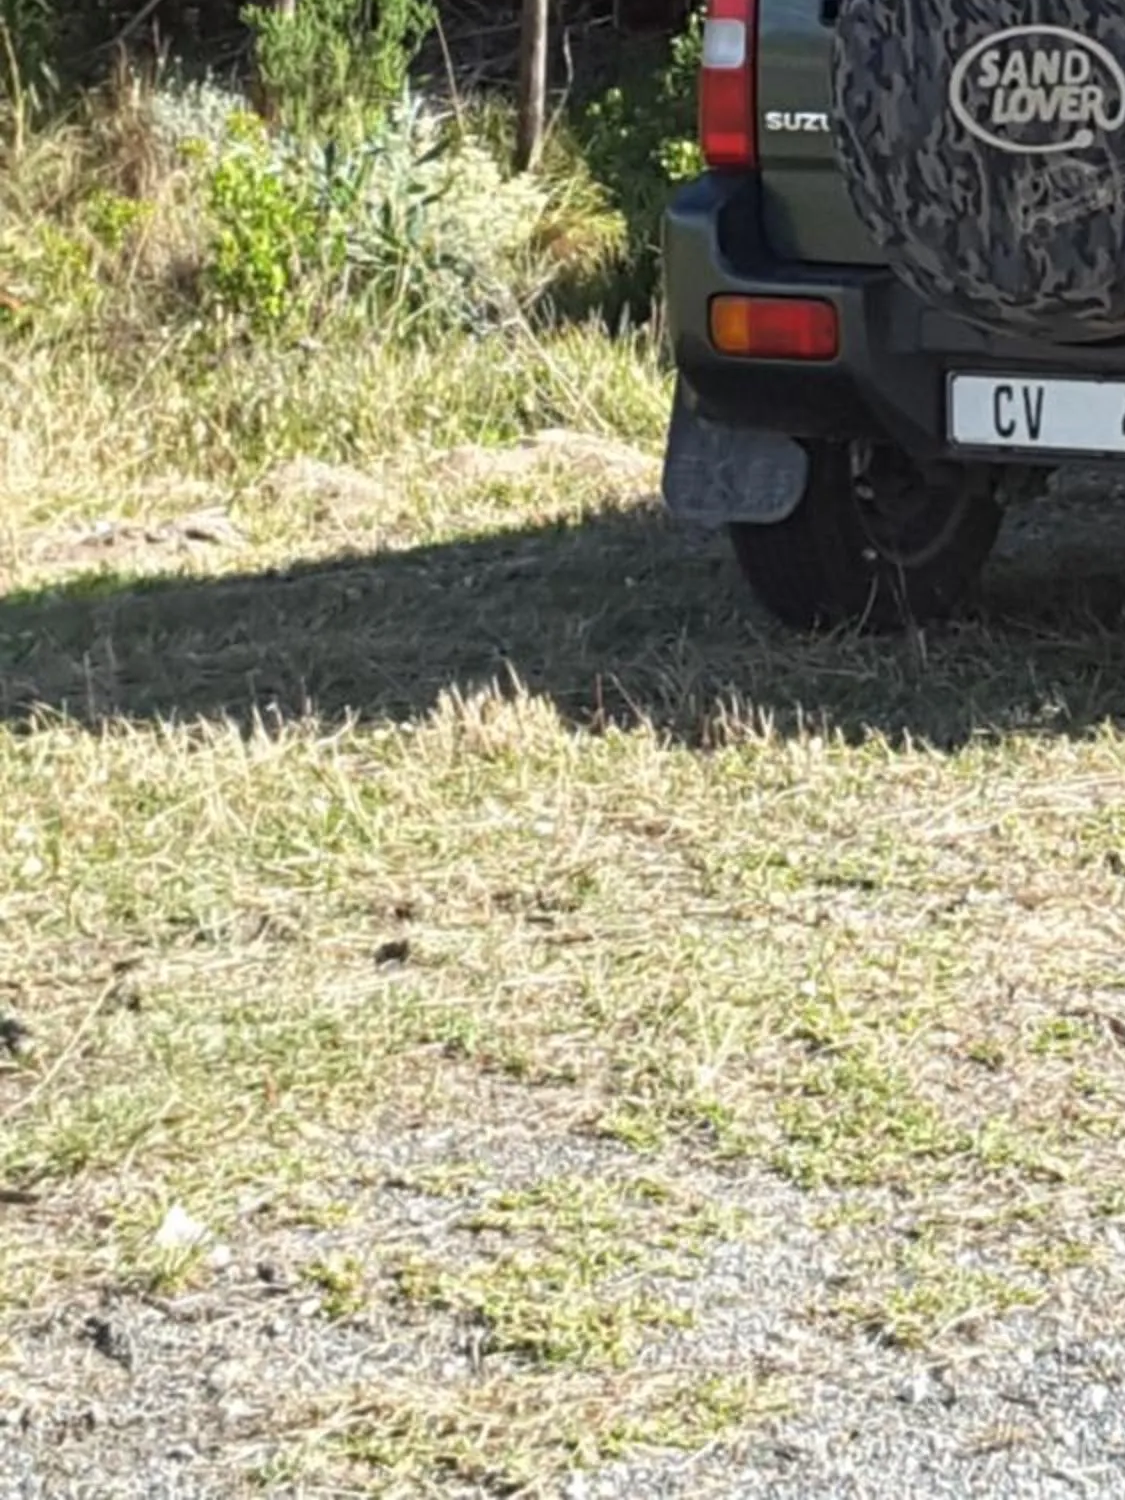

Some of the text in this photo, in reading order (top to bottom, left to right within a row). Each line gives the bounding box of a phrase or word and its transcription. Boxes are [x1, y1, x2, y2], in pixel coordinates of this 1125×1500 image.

[977, 49, 1091, 88] SAND
[991, 84, 1108, 126] LOVER
[993, 384, 1045, 441] CV
